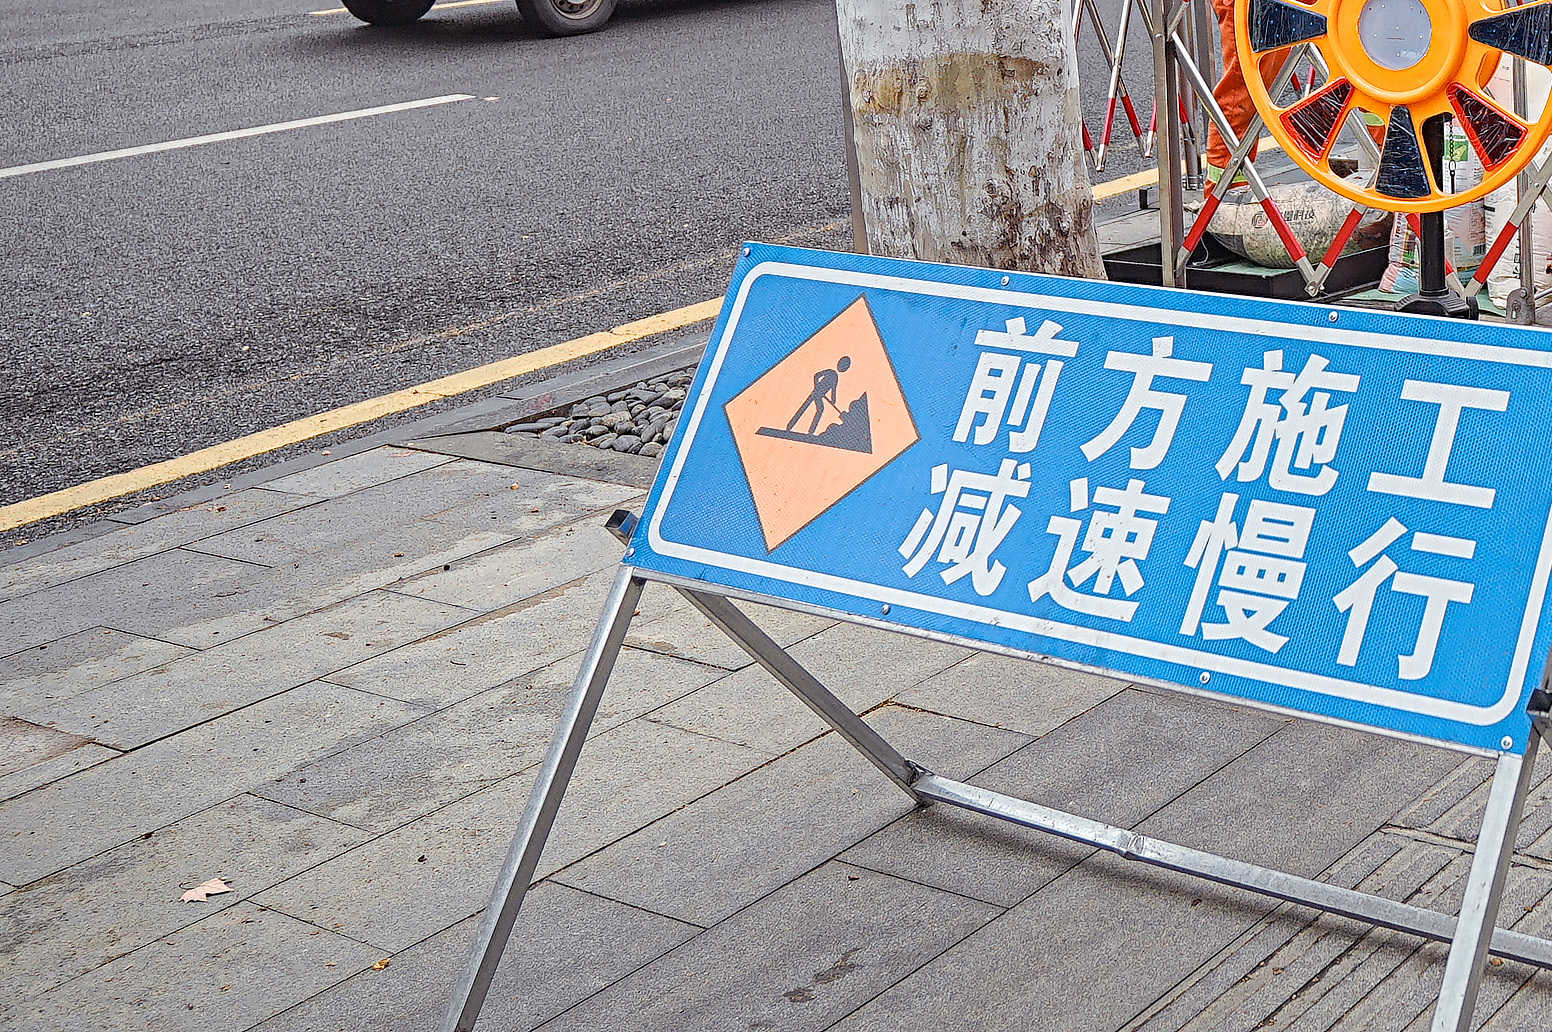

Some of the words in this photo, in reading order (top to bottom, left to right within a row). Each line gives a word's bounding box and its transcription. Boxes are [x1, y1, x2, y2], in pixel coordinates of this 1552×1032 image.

[952, 316, 1510, 509] 前方施工
[897, 457, 1477, 681] 减速慢行
